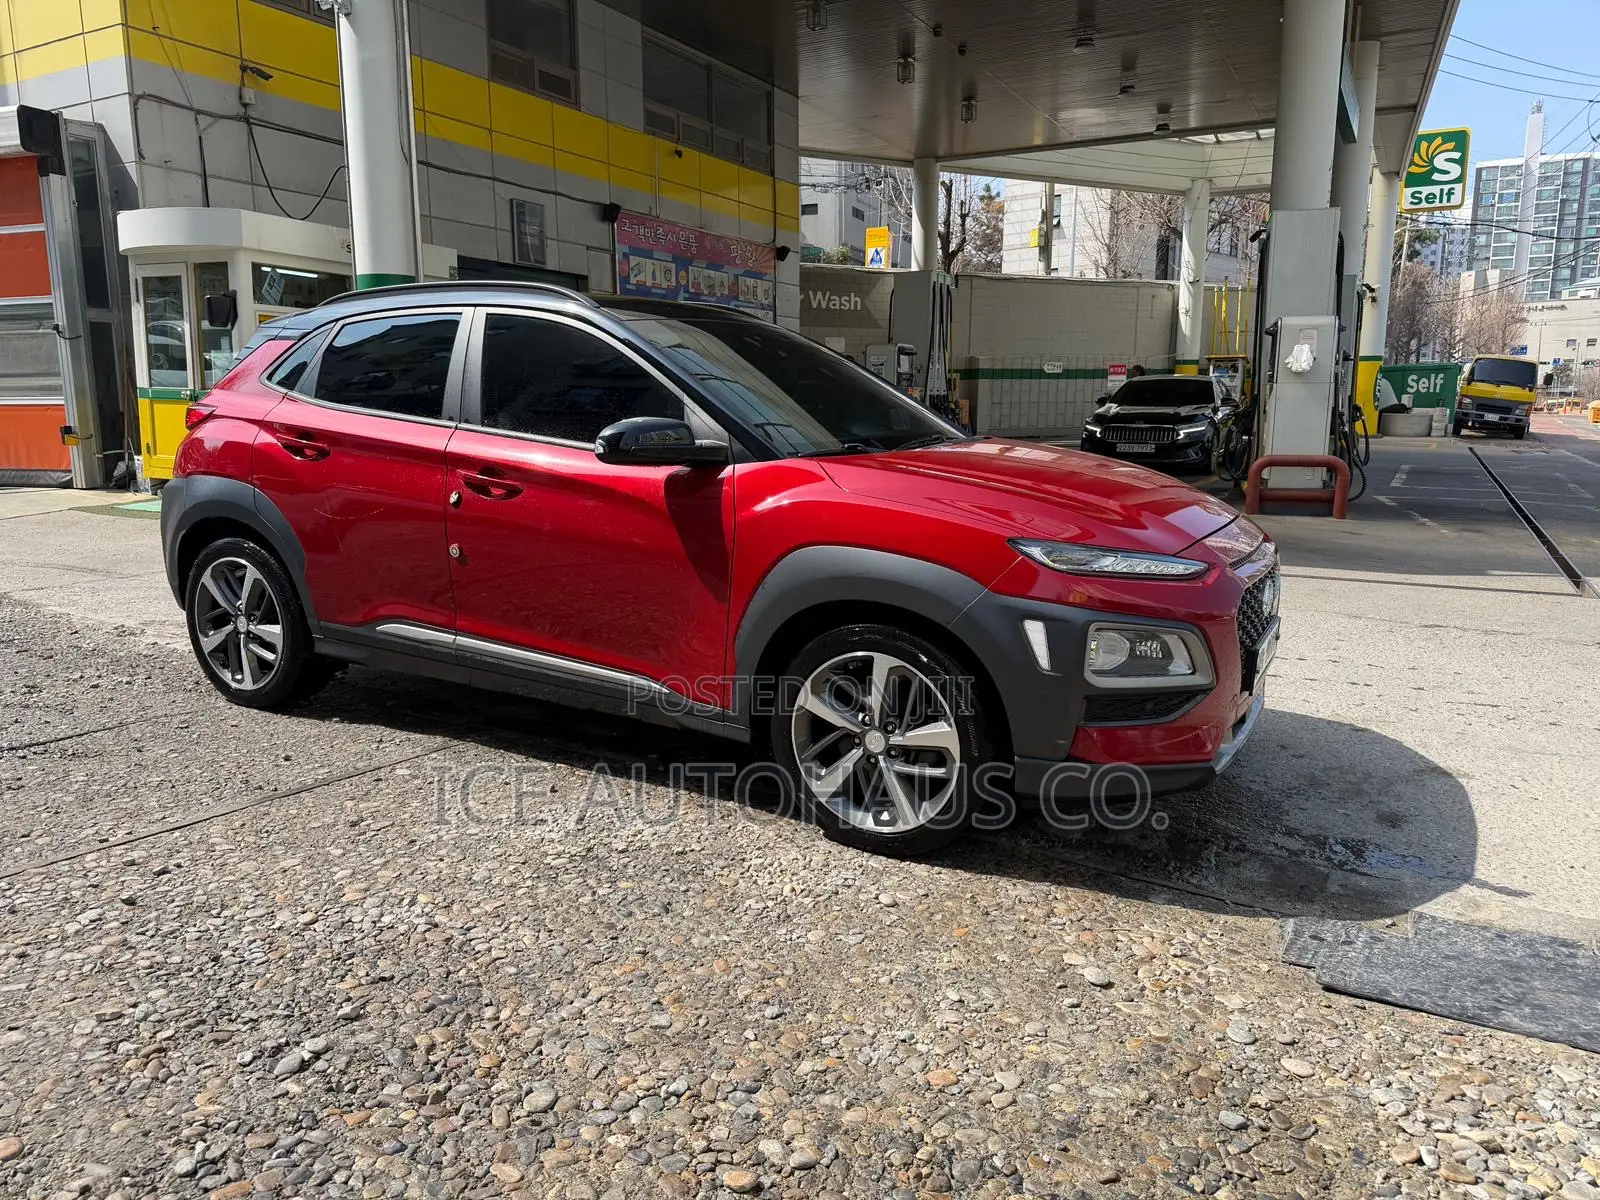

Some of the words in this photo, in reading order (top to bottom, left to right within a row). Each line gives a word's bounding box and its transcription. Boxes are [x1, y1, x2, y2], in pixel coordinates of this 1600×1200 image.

[1409, 187, 1456, 206] Self
[809, 290, 861, 311] Wash
[1406, 373, 1444, 393] Self
